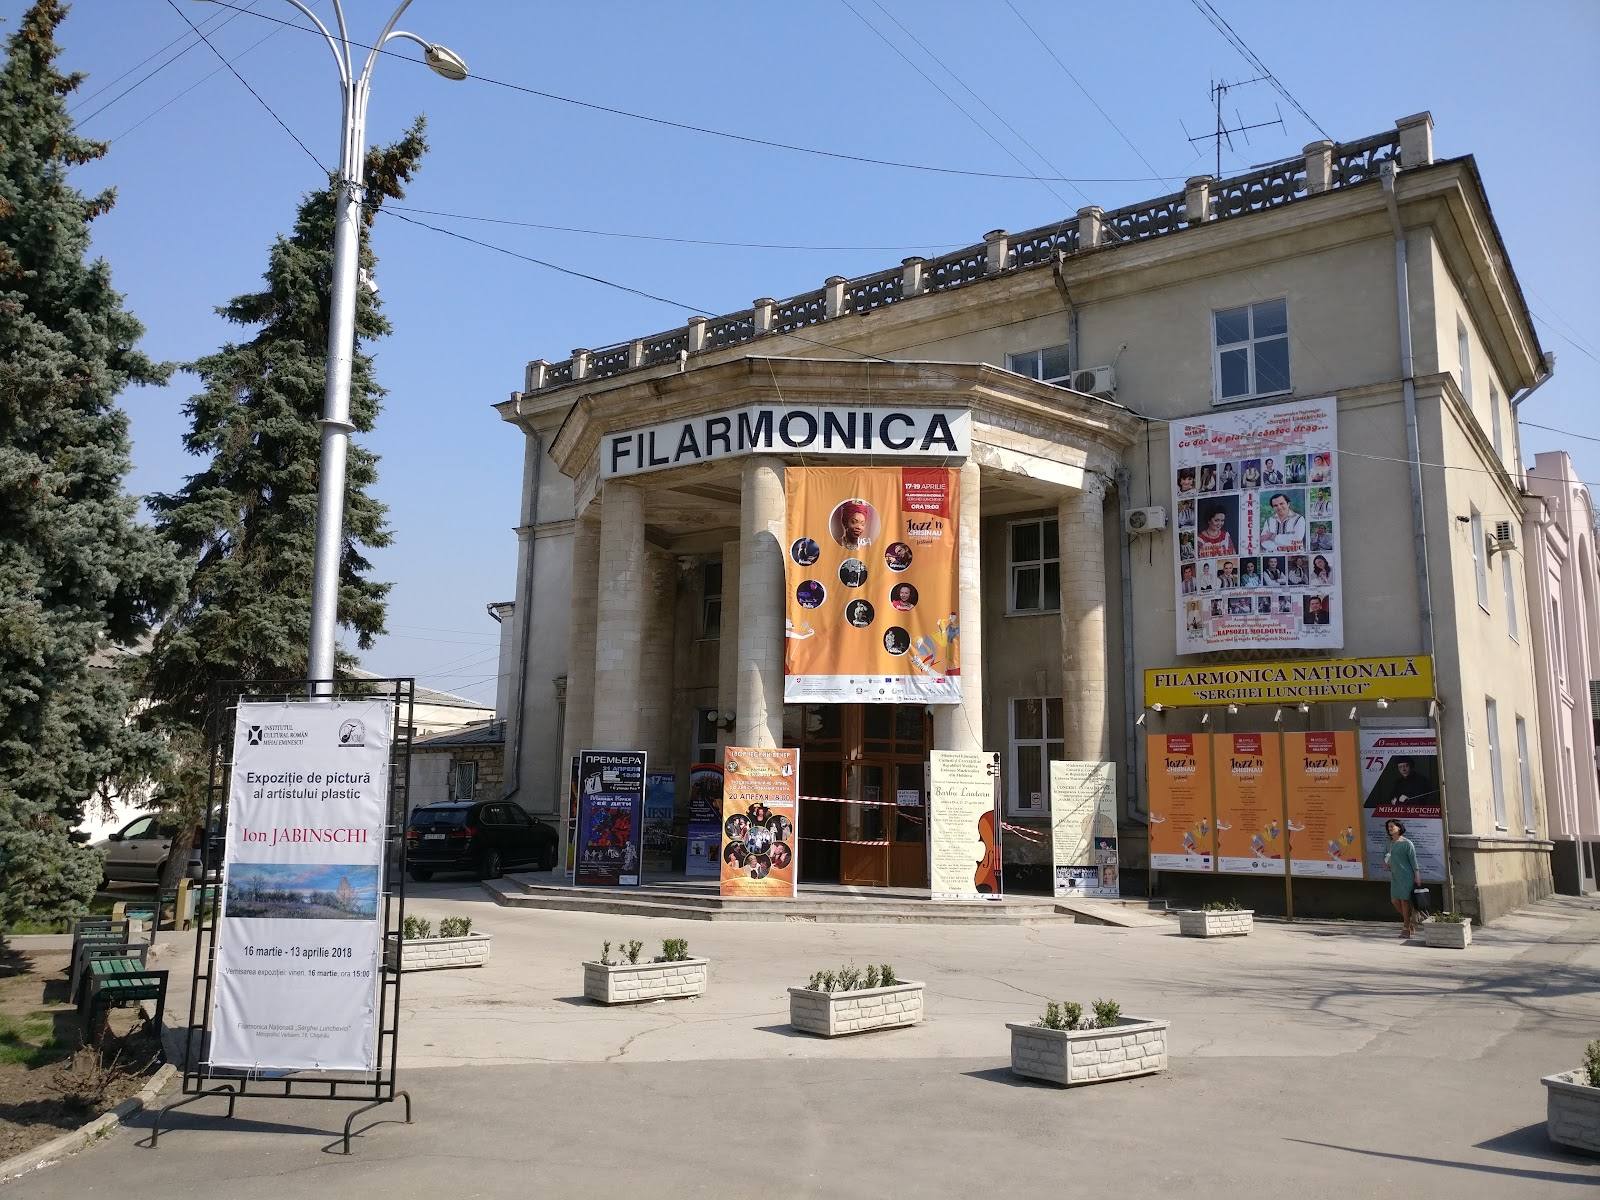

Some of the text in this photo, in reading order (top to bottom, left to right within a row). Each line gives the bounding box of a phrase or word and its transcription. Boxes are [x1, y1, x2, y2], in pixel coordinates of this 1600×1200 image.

[611, 410, 959, 473] FILARMONICA
[1154, 659, 1419, 687] FILARMONICA NAȚIONALĂ
[1193, 682, 1371, 701] “SERGHEI LUNCHEVICI”
[585, 755, 641, 764] ПРЕМЬЕРА
[1366, 756, 1385, 771] 75
[247, 772, 370, 786] Expoziție de pictură
[253, 788, 361, 801] al artistului plastic
[242, 828, 368, 847] Ion JABINSCHI
[244, 946, 254, 956] 16
[256, 946, 282, 957] martie
[290, 946, 300, 957] 13
[302, 946, 329, 960] aprilie
[332, 947, 352, 958] 2018
